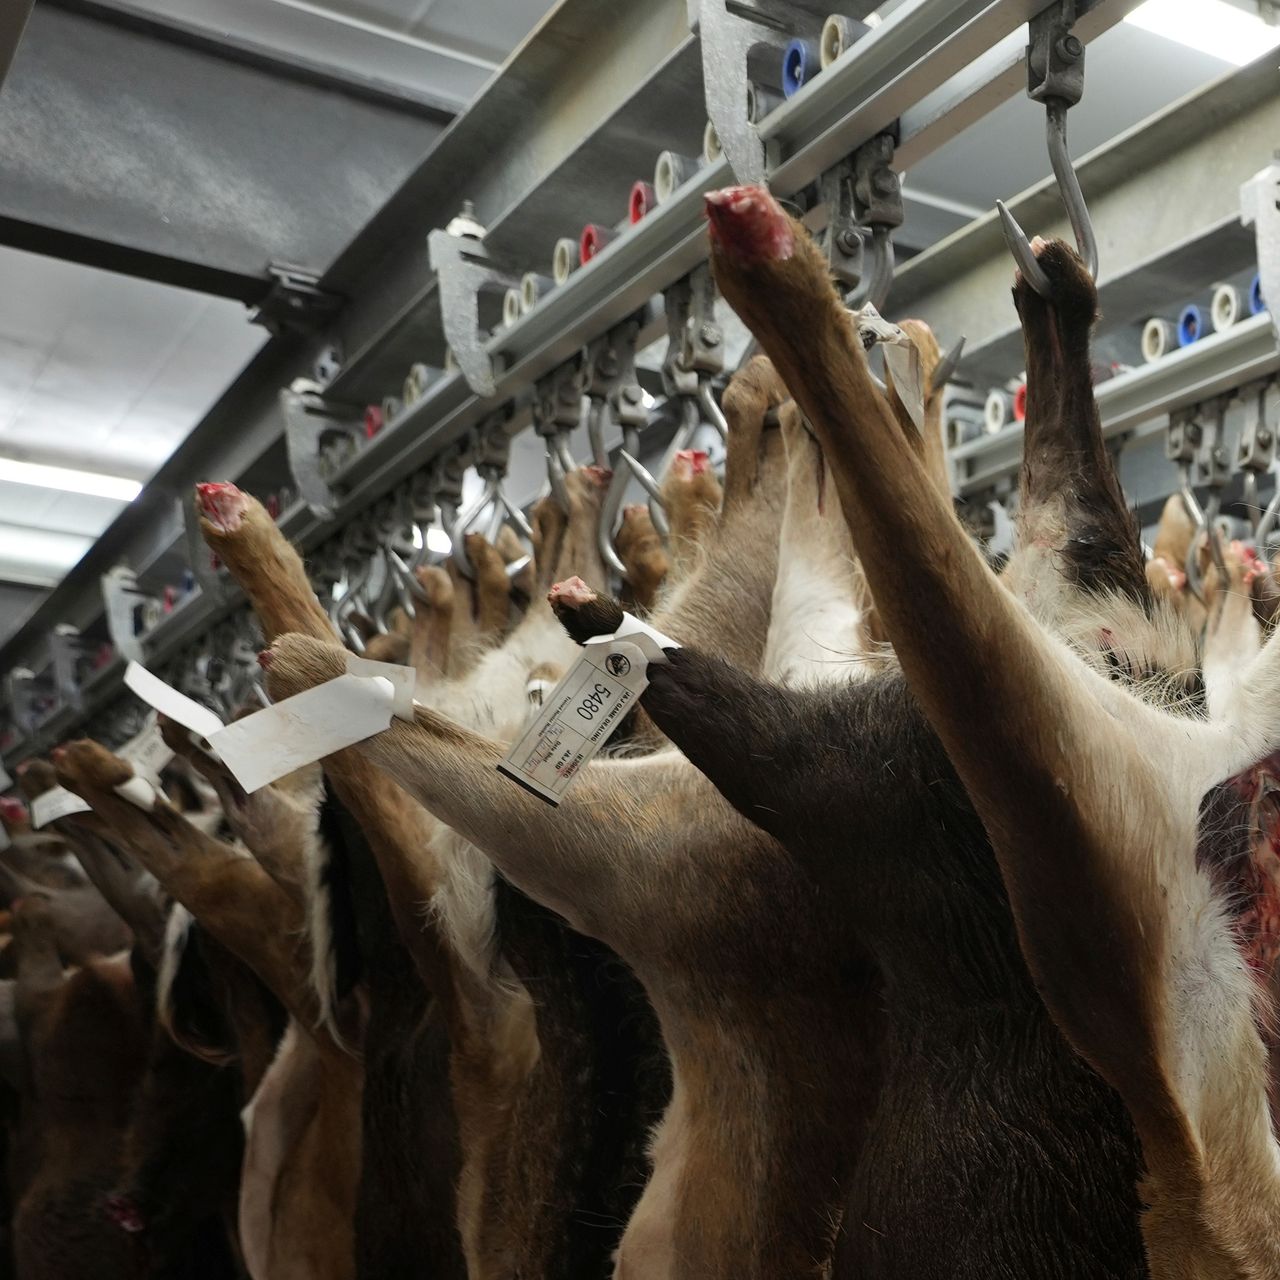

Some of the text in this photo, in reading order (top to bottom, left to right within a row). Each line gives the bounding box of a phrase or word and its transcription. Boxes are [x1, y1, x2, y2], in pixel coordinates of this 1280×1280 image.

[576, 683, 612, 720] 5480
[608, 702, 623, 719] GAME
[590, 718, 611, 742] DEALING
